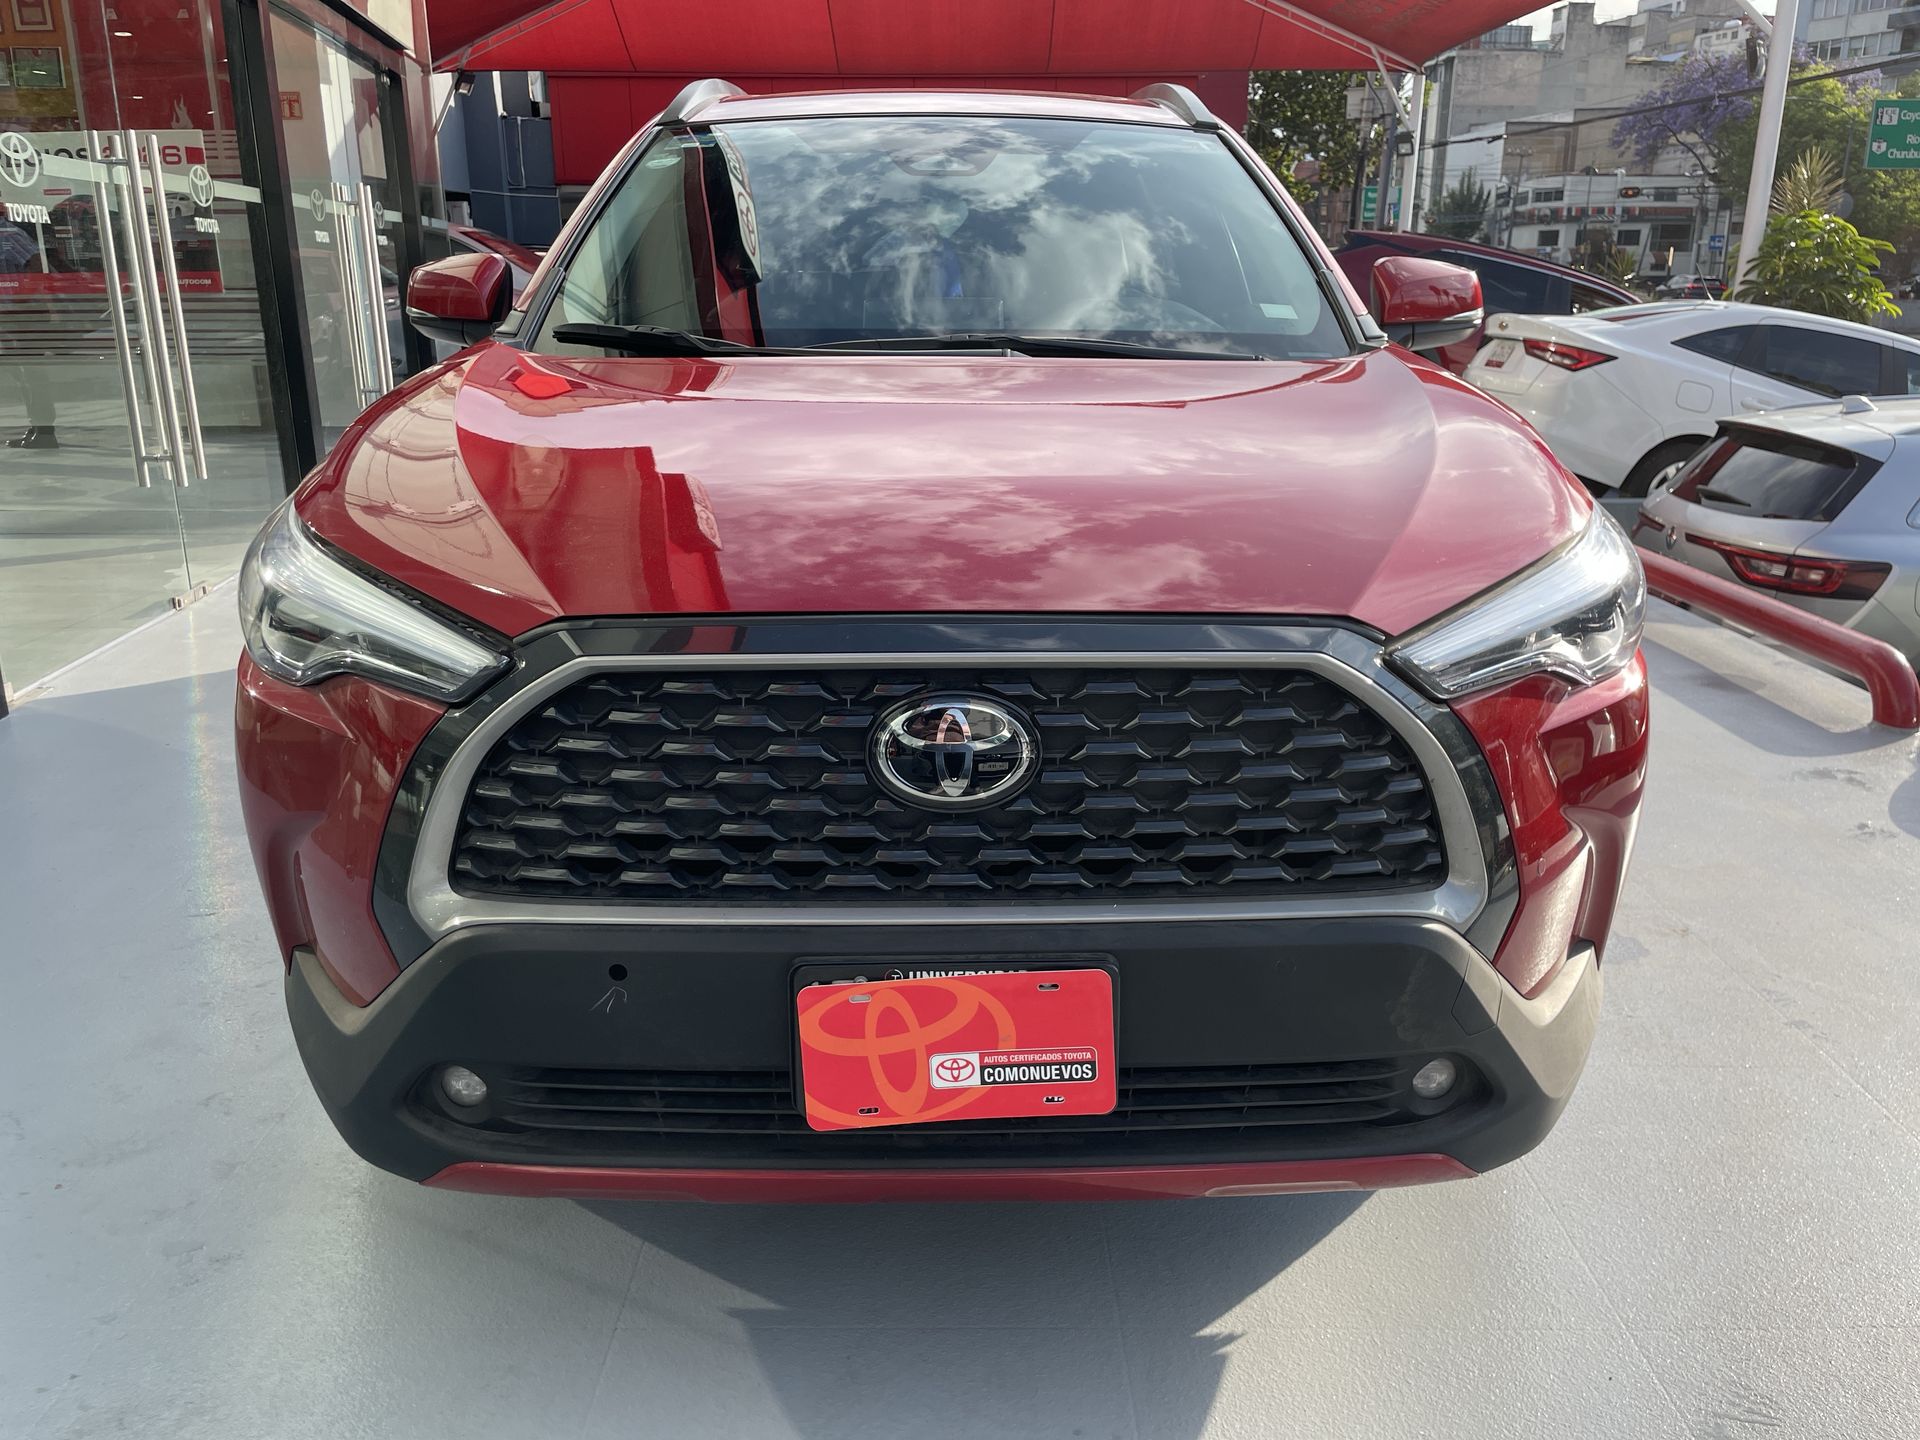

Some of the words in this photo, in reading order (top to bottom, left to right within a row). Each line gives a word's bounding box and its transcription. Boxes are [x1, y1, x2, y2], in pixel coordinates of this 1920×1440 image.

[5, 203, 52, 224] TOYOTA
[194, 217, 220, 234] TOYOTA
[984, 1055, 1008, 1063] AUTOS
[1009, 1053, 1062, 1062] CERTIFICADOS
[1063, 1052, 1092, 1060] TOYOTA
[983, 1063, 1093, 1082] COMONUEVOS
